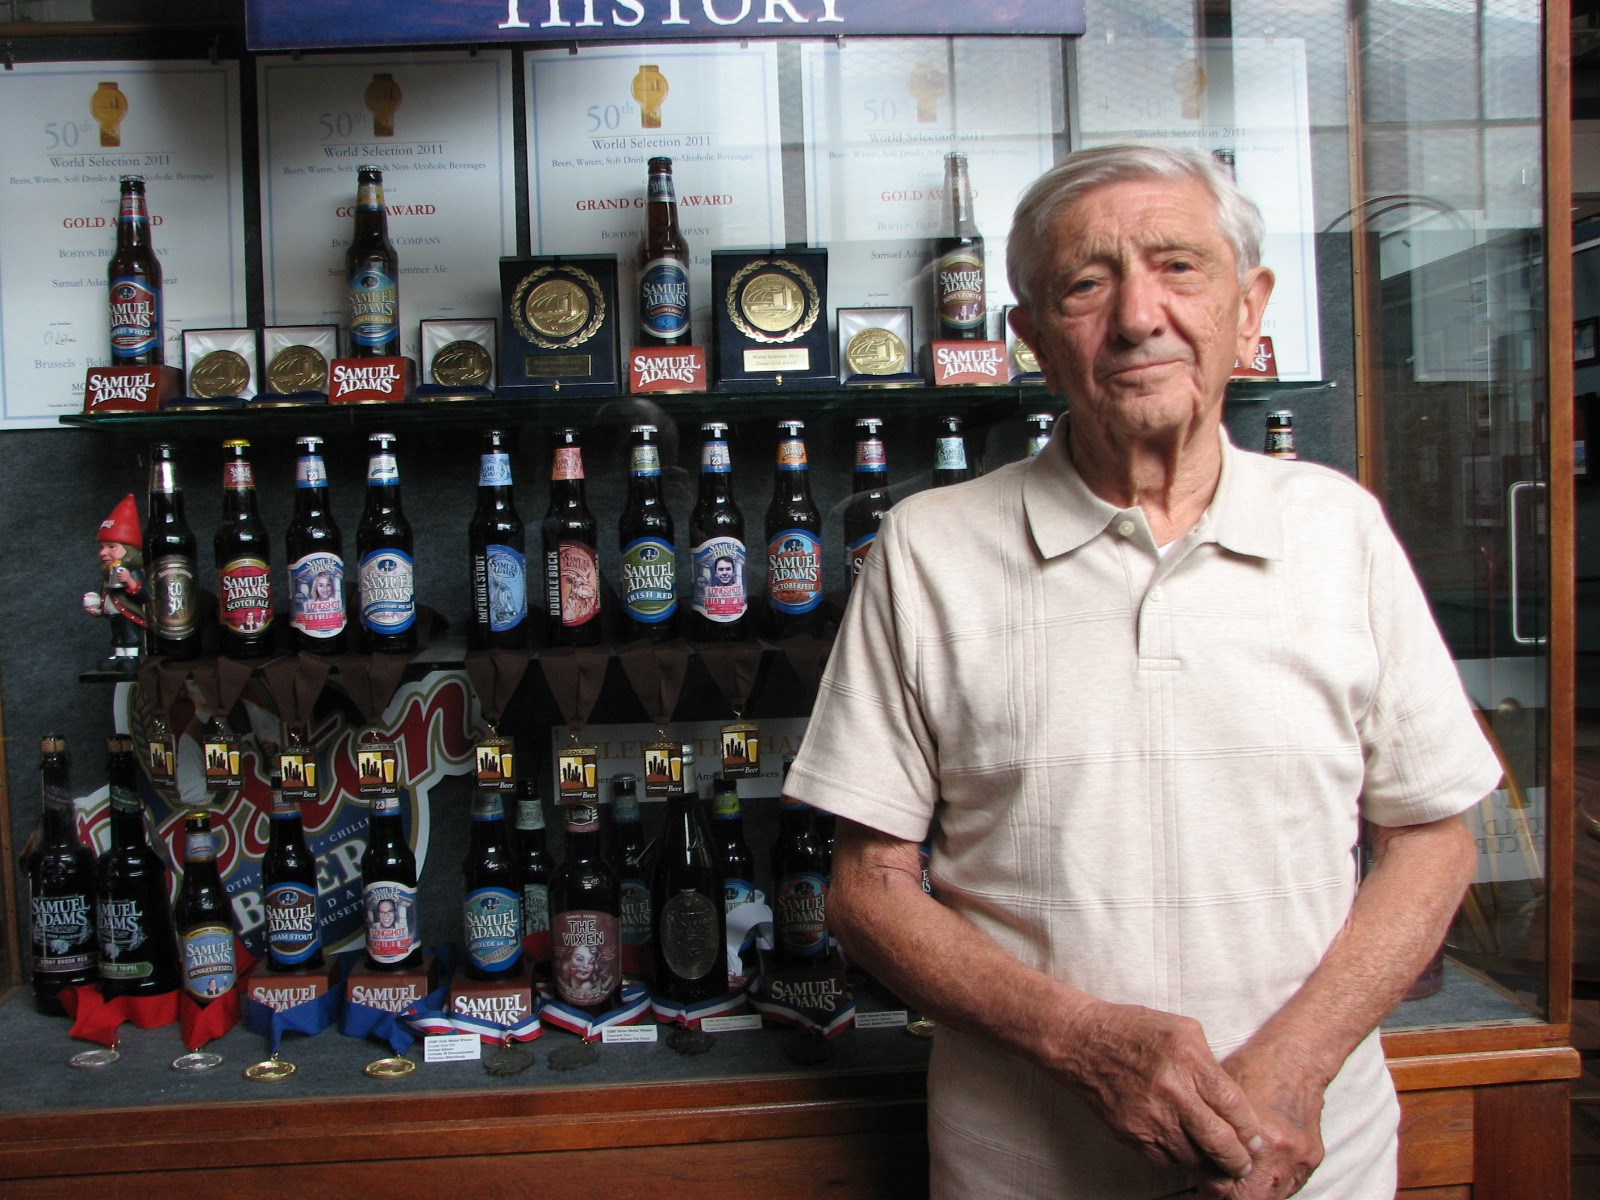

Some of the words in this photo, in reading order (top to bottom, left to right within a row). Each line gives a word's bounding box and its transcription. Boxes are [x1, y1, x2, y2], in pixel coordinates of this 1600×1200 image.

[592, 138, 627, 150] World
[630, 136, 681, 148] Selection
[685, 135, 711, 147] 2011
[869, 132, 902, 144] World
[323, 146, 360, 158] World
[362, 144, 413, 157] Selection
[417, 144, 443, 155] 2011
[50, 157, 85, 169] World
[89, 156, 140, 168] Selection
[144, 155, 170, 166] 2011
[449, 161, 486, 171] Beverages
[576, 158, 604, 167] Waters,
[606, 157, 622, 166] Soft
[576, 198, 630, 212] GRAND
[680, 194, 734, 207] AWARD
[881, 190, 923, 202] GOLD
[385, 203, 436, 216] AWARD
[63, 217, 106, 229] GOLD
[396, 235, 442, 248] COMPANY
[601, 229, 639, 240] BOSTON
[59, 249, 94, 259] BOSTON
[870, 250, 902, 260] Samuel
[432, 262, 448, 273] Ale
[52, 278, 84, 288] Samuel
[939, 269, 983, 287] SAMUEL
[642, 281, 688, 298] SAMUEL
[942, 281, 982, 296] ADAMS
[348, 288, 395, 306] SAMUEL
[646, 293, 687, 308] ADAMS
[351, 302, 394, 317] ADAMS
[111, 314, 152, 328] ADAMS
[633, 354, 701, 373] SAMUEL
[937, 347, 1003, 365] SAMUEL
[35, 358, 76, 370] Brussels
[942, 360, 998, 380] ADAMS
[333, 364, 400, 383] SAMUEL
[637, 367, 696, 388] ADAMS
[89, 372, 155, 391] SAMUEL
[335, 377, 395, 398] ADAMS
[90, 386, 150, 407] ADAMS
[711, 455, 722, 466] 23
[308, 471, 319, 481] 23
[708, 542, 739, 553] SAMUEL
[306, 556, 337, 568] SAMUEL
[474, 555, 487, 582] STOUT
[490, 558, 518, 572] SAMUEL
[547, 551, 559, 577] BOCK
[768, 553, 820, 571] SAMUEL
[491, 567, 516, 579] ADAMS
[624, 562, 674, 580] SAMUEL
[772, 566, 818, 584] ADAMS
[222, 573, 271, 591] SAMUEL
[362, 572, 413, 591] SAMUEL
[627, 575, 672, 593] ADAMS
[773, 582, 815, 593] OCTOBERFEST
[227, 585, 269, 601] ADAMS
[366, 586, 411, 602] ADAMS
[549, 579, 561, 616] DOUBLE
[627, 590, 653, 604] IRISH
[655, 590, 674, 600] RED
[707, 585, 741, 595] LONGSHOT
[226, 599, 255, 611] SCOTCH
[255, 599, 270, 609] ALE
[306, 600, 341, 611] LONGSHOT
[477, 581, 489, 623] IMPERIAL
[744, 766, 759, 775] Beer
[227, 778, 241, 787] Beer
[499, 781, 514, 790] Beer
[667, 784, 683, 793] Beer
[302, 789, 318, 799] Beer
[381, 786, 397, 795] Beer
[581, 791, 597, 800] Beer
[375, 801, 386, 810] 23
[230, 838, 368, 938] BER
[371, 887, 401, 897] SAMUEL
[32, 894, 91, 914] SAMUEL
[100, 900, 143, 918] MUEL
[777, 894, 825, 912] SAMUEL
[34, 911, 88, 927] ADAMS
[266, 903, 315, 922] SAMUEL
[467, 909, 518, 928] SAMUEL
[782, 908, 825, 923] ADAMS
[100, 917, 140, 932] DAMS
[269, 918, 312, 932] ADAMS
[470, 923, 515, 941] ADAMS
[568, 919, 597, 934] THE
[289, 932, 314, 941] STOUT
[372, 928, 405, 937] LONGSHOT
[562, 931, 605, 947] VIXEN
[186, 939, 232, 958] SAMUEL
[190, 952, 231, 968] ADAMS
[119, 964, 138, 972] TRIPEL
[253, 984, 317, 1002] SAMUEL
[352, 984, 421, 1002] SAMUEL
[771, 978, 842, 1000] SAMUEL
[454, 994, 527, 1014] SAMUEL
[784, 995, 837, 1012] DAMS
